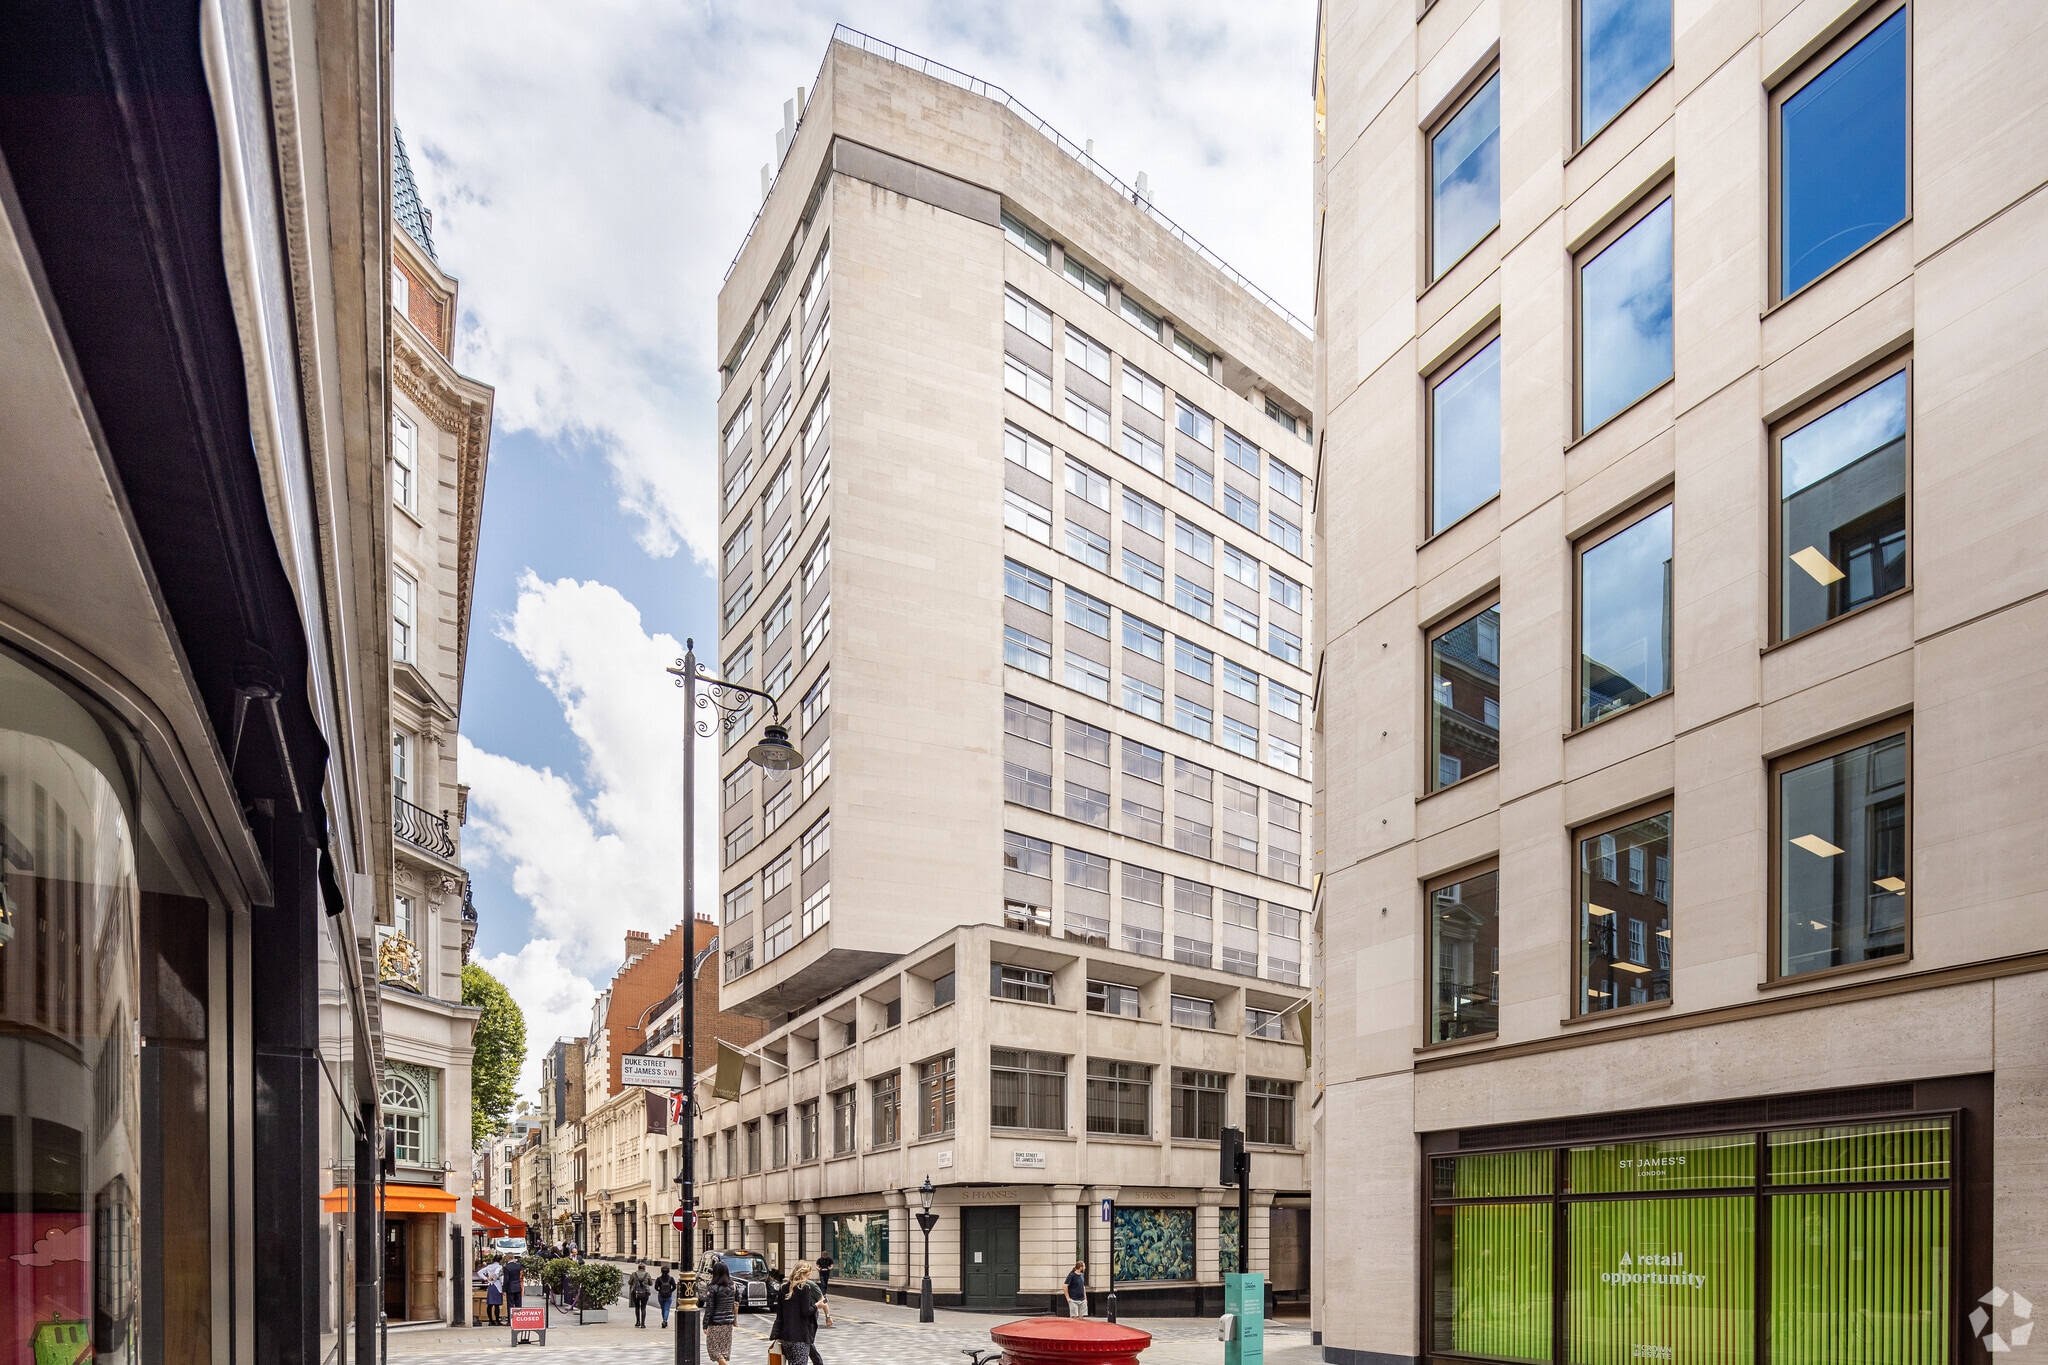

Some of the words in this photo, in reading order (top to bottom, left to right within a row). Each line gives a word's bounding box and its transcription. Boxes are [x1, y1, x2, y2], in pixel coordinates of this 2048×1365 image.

[625, 1058, 642, 1066] DUKE
[1620, 1160, 1633, 1168] ST
[1637, 1157, 1686, 1167] JAMES'S
[963, 1191, 969, 1199] S
[973, 1191, 1017, 1199] FRANSES
[1135, 1191, 1141, 1199] S
[1143, 1191, 1176, 1199] FRANSES
[1620, 1251, 1632, 1265] A
[1638, 1252, 1683, 1266] retail
[1602, 1271, 1705, 1289] opportunity
[1642, 1345, 1671, 1353] CROWN
[1642, 1351, 1671, 1359] ESTATE
